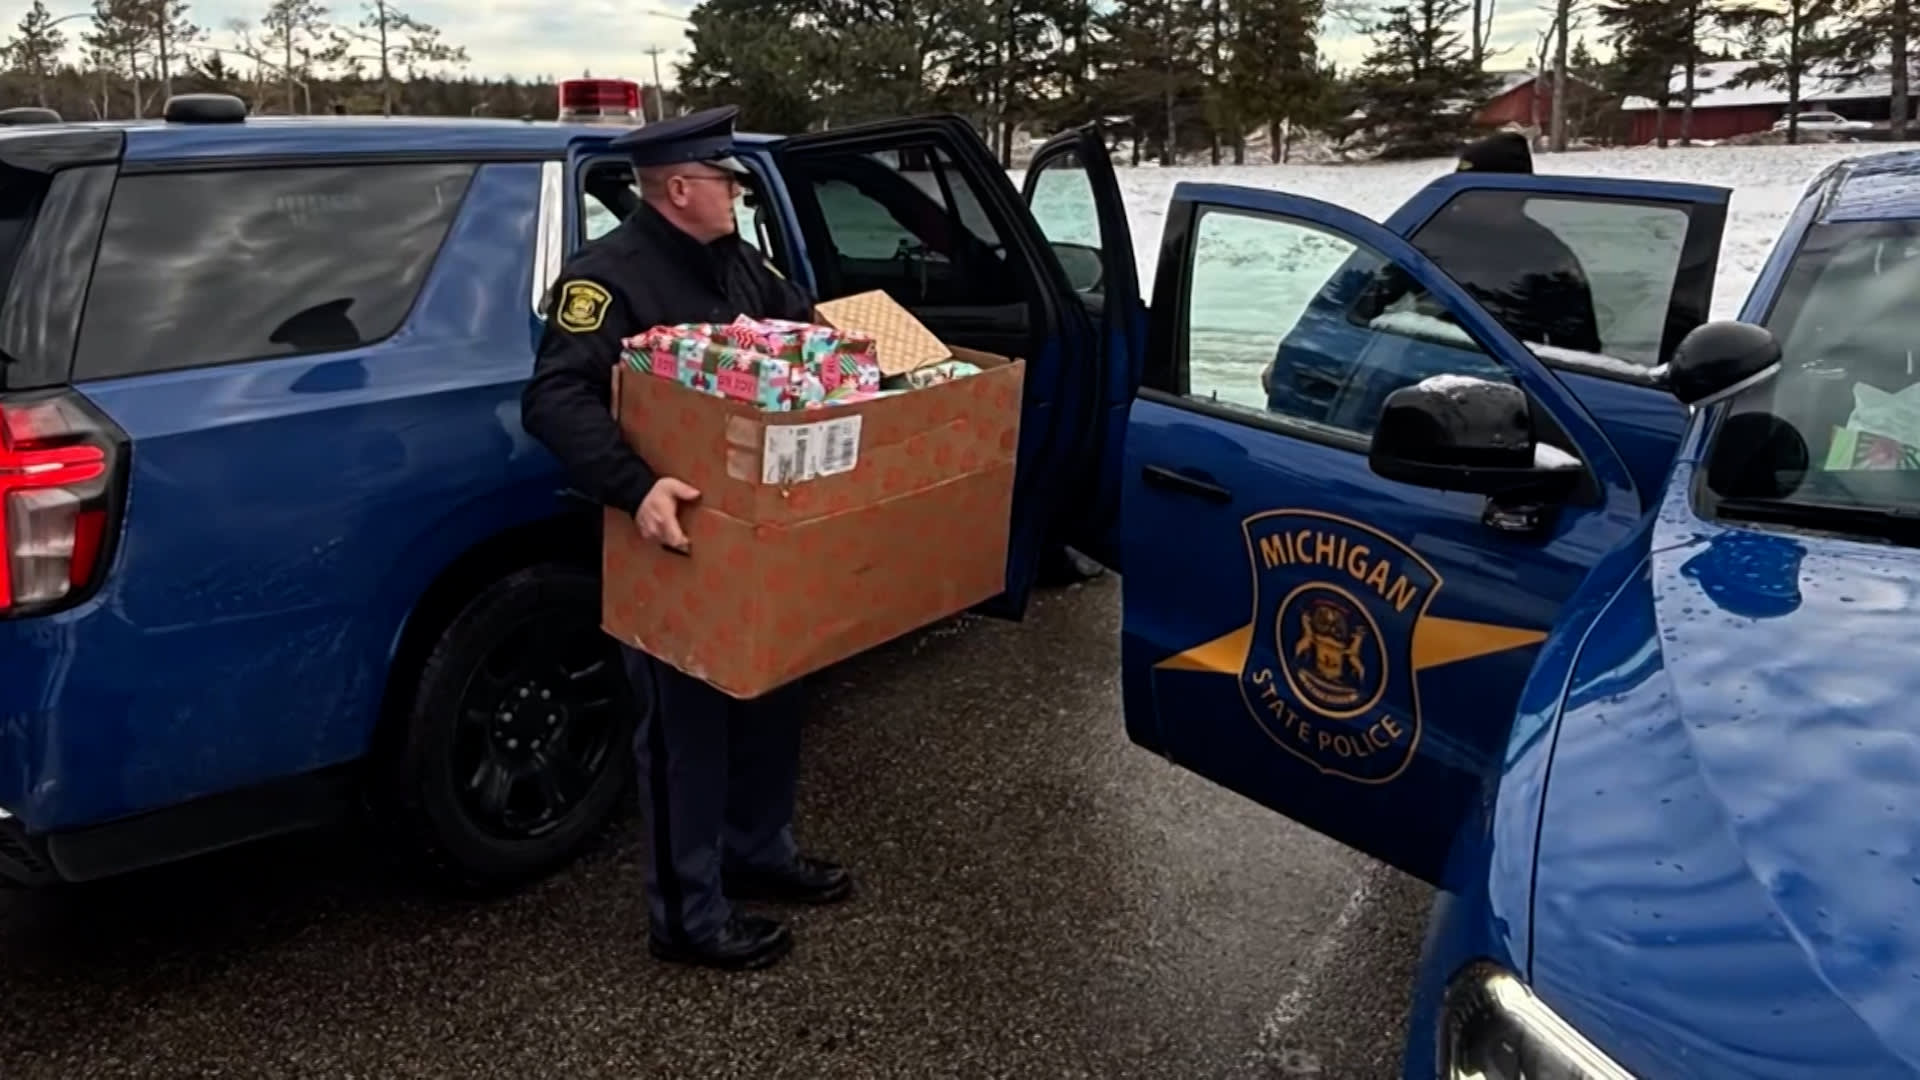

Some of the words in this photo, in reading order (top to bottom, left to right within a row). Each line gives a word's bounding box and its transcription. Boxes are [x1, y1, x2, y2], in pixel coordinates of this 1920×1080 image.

[1259, 529, 1417, 613] MICHIGAN
[1252, 668, 1311, 741] STATE
[1318, 714, 1403, 758] POLICE
